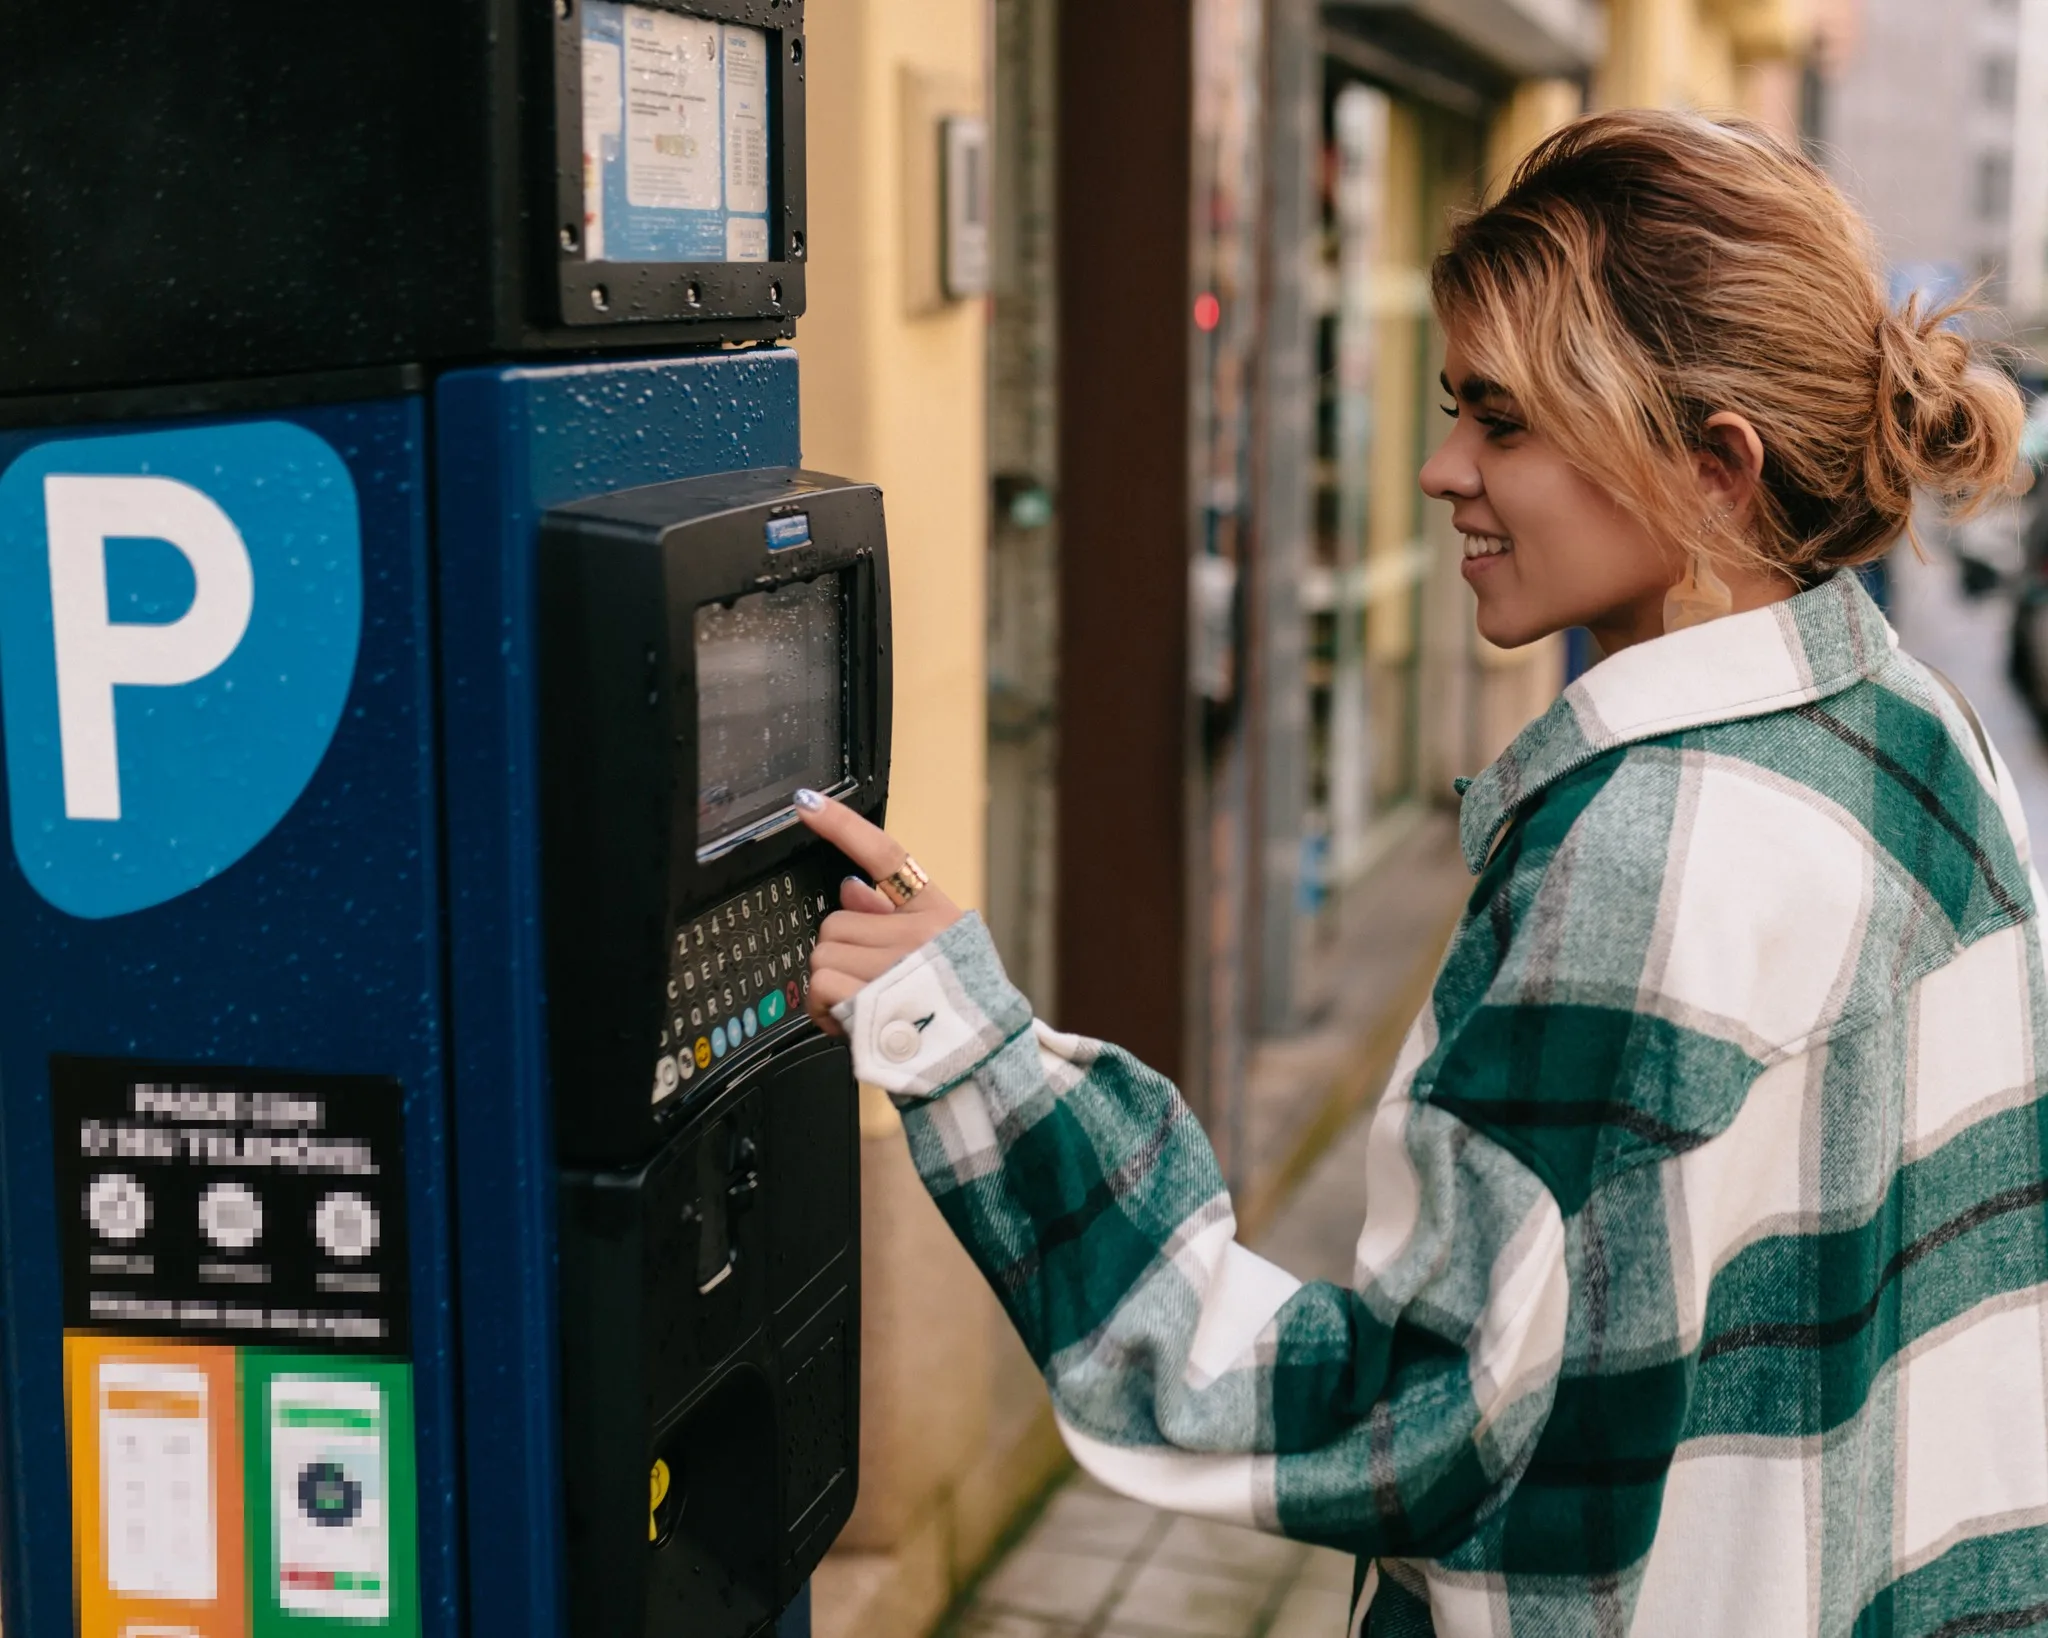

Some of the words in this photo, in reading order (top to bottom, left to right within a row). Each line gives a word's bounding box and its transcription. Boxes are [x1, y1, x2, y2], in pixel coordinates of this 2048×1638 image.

[44, 473, 254, 821] P
[667, 980, 678, 999] C
[684, 971, 695, 990] D
[701, 962, 711, 980] E
[717, 953, 726, 971] F
[733, 944, 742, 963] G
[748, 936, 757, 952] H
[778, 919, 784, 935] J
[790, 912, 799, 928] K
[804, 904, 812, 920] L
[816, 896, 826, 912] M
[677, 934, 689, 955] 2
[694, 924, 705, 945] 3
[711, 915, 720, 935] 4
[727, 907, 736, 927] 5
[741, 899, 750, 918] 6
[756, 891, 763, 911] 7
[771, 884, 779, 902] 8
[784, 876, 792, 895] 9
[674, 1018, 684, 1036] P
[691, 1008, 701, 1026] Q
[707, 998, 718, 1017] R
[724, 988, 733, 1006] S
[739, 979, 748, 996] T
[754, 971, 763, 987] U
[769, 961, 777, 977] V
[781, 953, 791, 970] W
[796, 944, 805, 961] X
